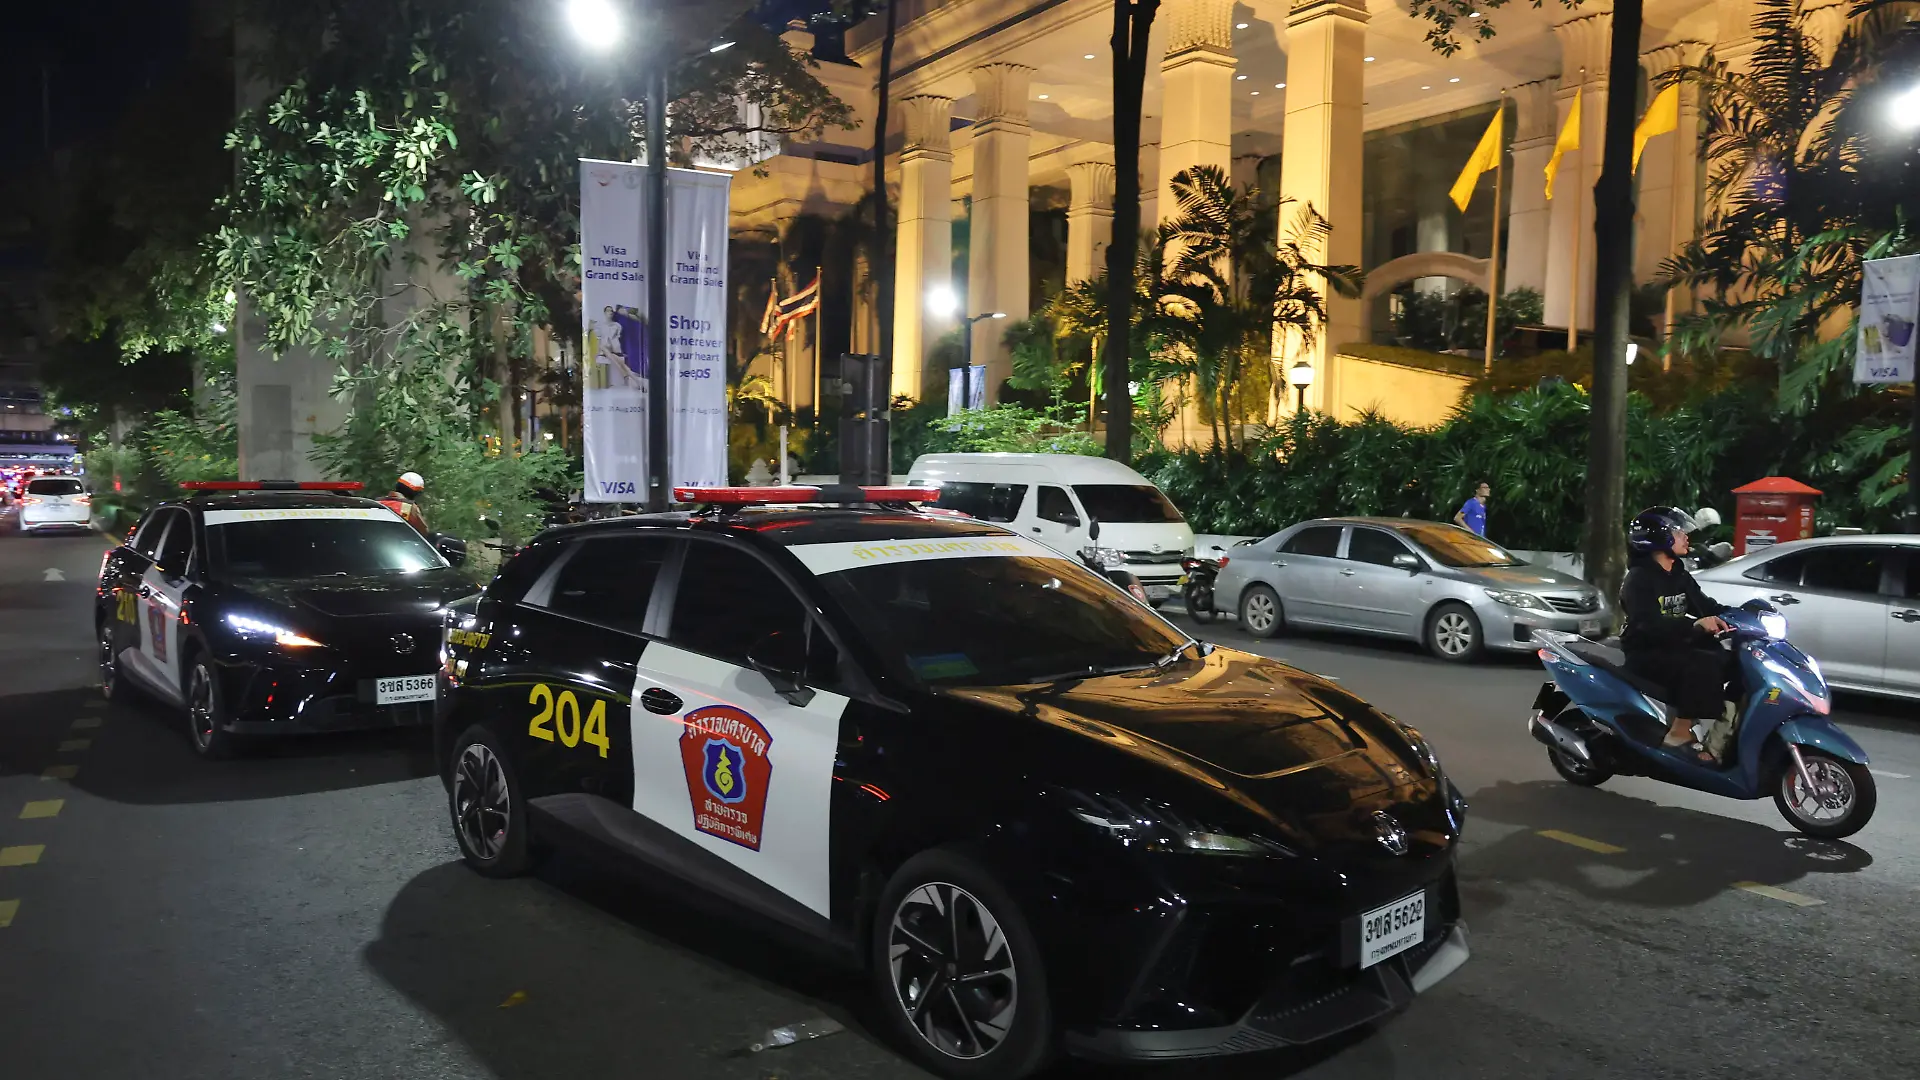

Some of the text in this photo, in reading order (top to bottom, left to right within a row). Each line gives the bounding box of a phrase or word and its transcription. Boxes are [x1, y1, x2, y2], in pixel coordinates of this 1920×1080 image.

[603, 245, 627, 255] Visa
[590, 257, 639, 269] Thailand
[676, 262, 719, 275] Thailnd
[585, 270, 644, 282] Grand Sale
[703, 277, 723, 288] Sale
[669, 315, 711, 334] Shop
[669, 335, 723, 348] wherever
[694, 351, 720, 362] heart
[1870, 367, 1899, 378] VISA
[600, 481, 635, 494] VISA
[406, 678, 434, 691] 5366
[528, 683, 610, 759] 204
[688, 713, 766, 757] ตำรวจนครบาล
[704, 798, 749, 825] สายตรวจ
[696, 813, 758, 844] ปฏิบัติการพิเศษ
[1394, 899, 1423, 931] 5622
